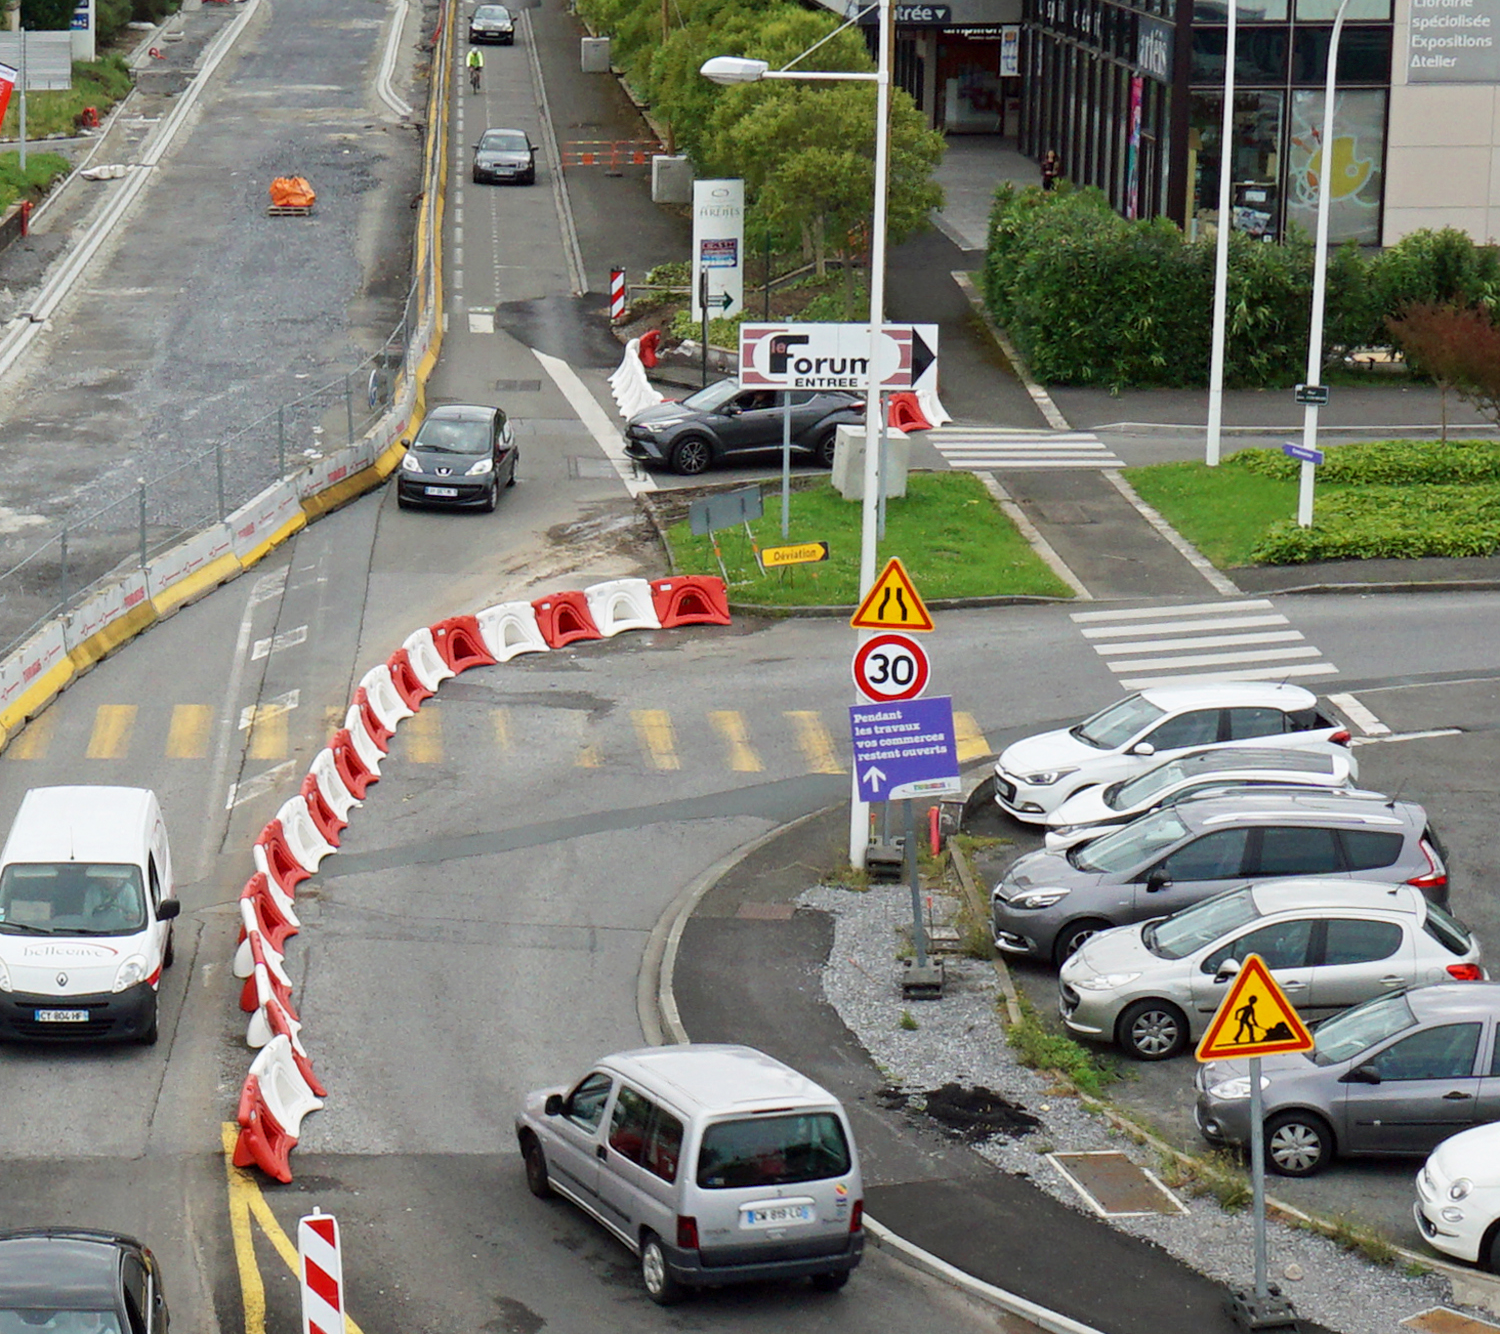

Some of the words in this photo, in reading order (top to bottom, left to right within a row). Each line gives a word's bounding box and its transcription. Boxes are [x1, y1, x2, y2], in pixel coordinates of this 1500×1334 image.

[1411, 13, 1491, 30] spécialisée
[1410, 34, 1493, 49] Expositions
[1409, 54, 1458, 68] Atelier
[770, 340, 786, 354] le
[794, 377, 858, 388] ENTREE
[773, 547, 817, 562] Déviation
[868, 653, 915, 686] 30
[853, 710, 903, 724] Pendant
[854, 726, 873, 736] les
[873, 722, 921, 735] travaux
[856, 739, 878, 749] vos
[879, 732, 945, 747] commerces
[857, 748, 901, 762] restent
[902, 744, 948, 758] ouverts
